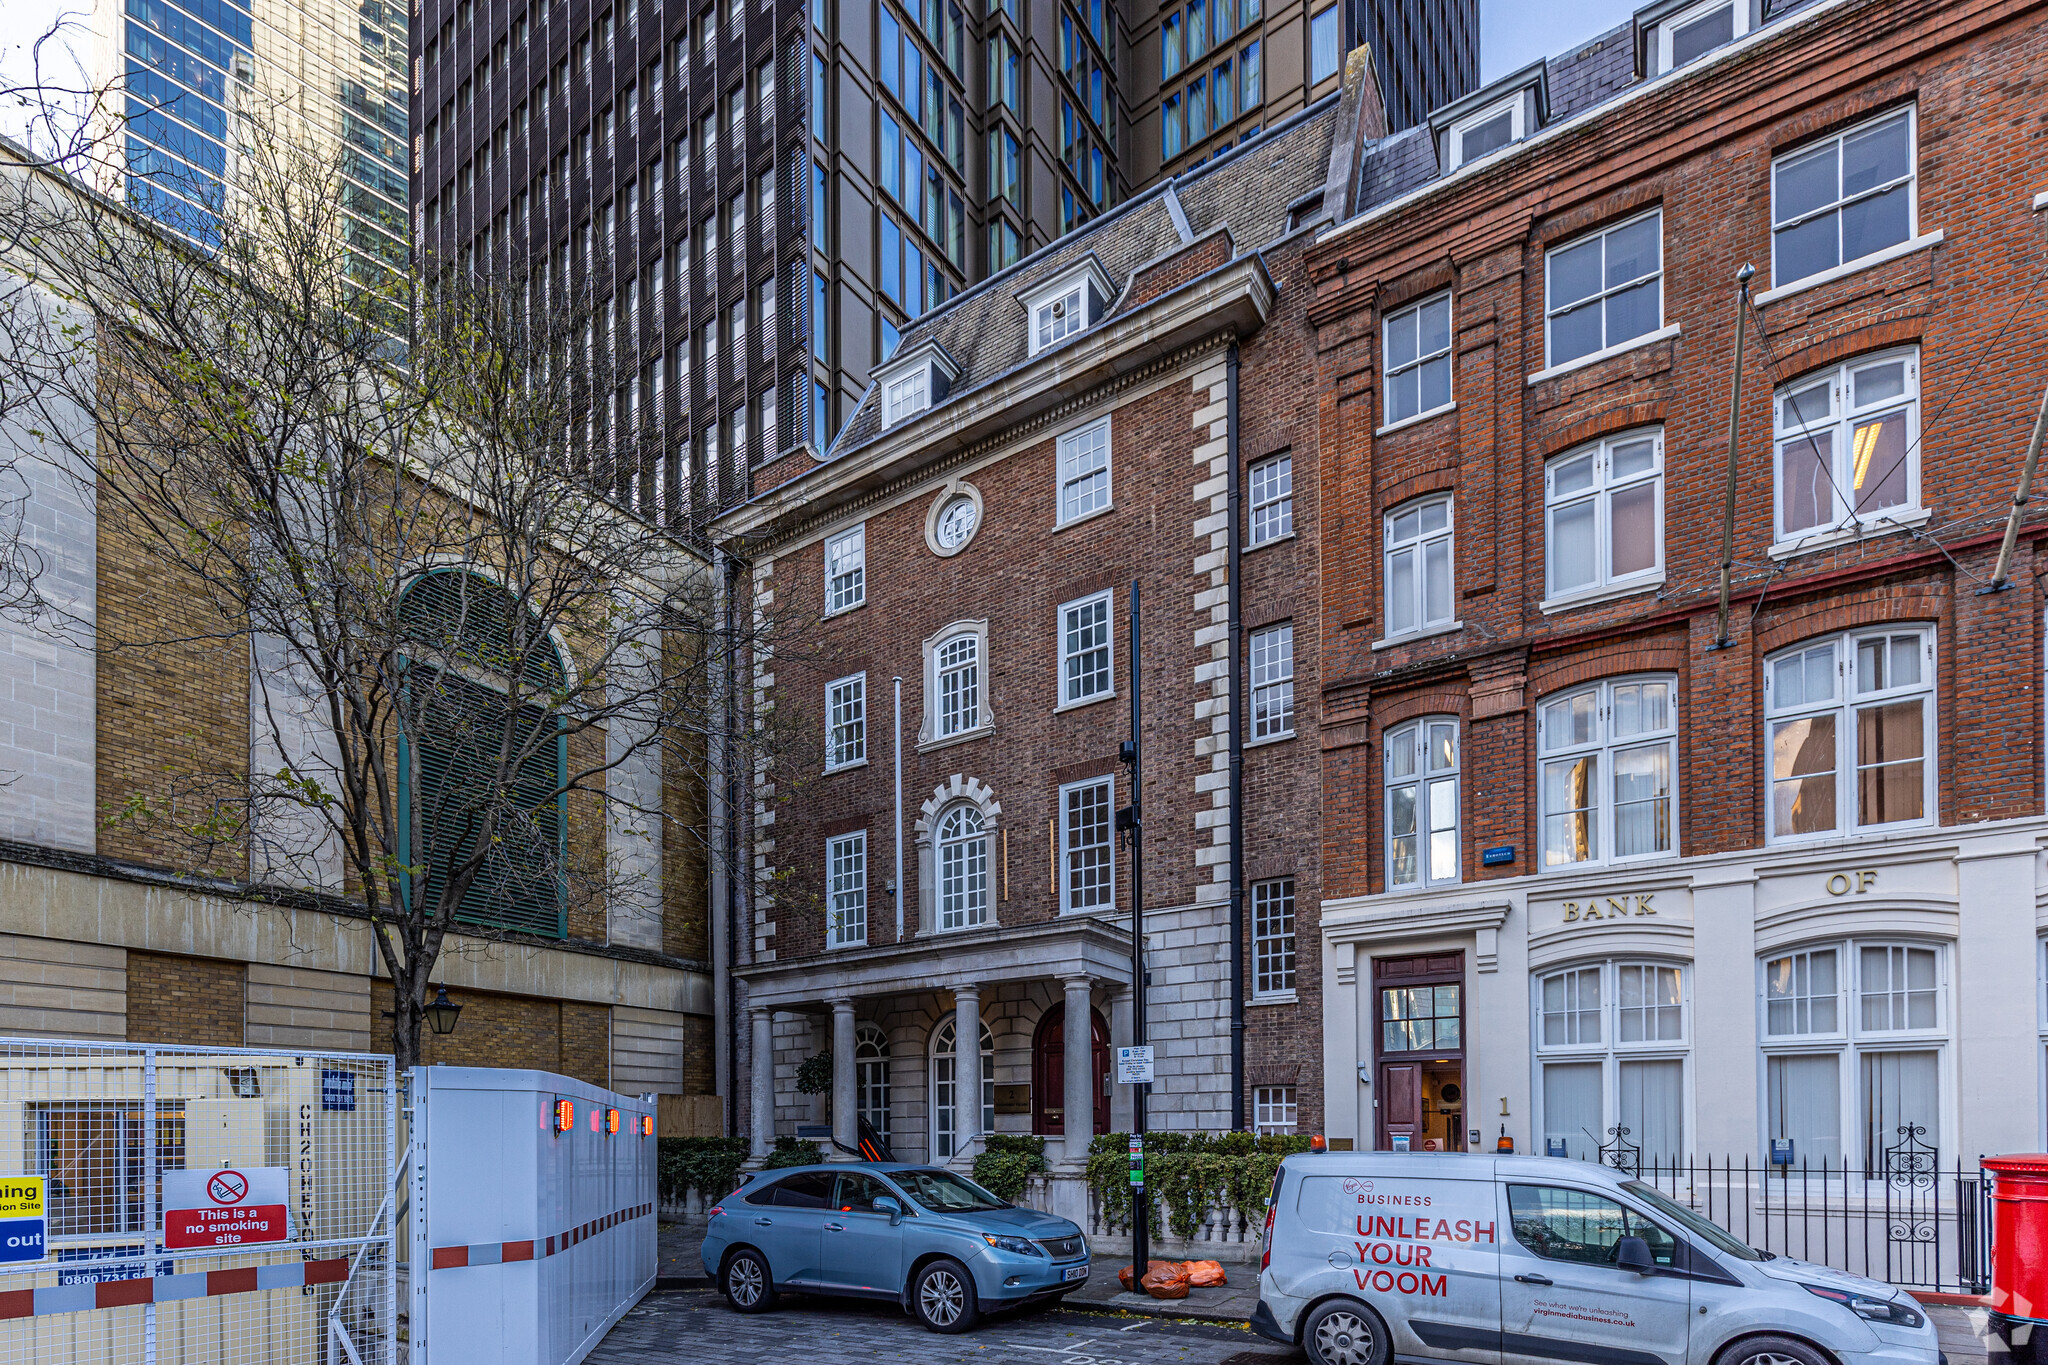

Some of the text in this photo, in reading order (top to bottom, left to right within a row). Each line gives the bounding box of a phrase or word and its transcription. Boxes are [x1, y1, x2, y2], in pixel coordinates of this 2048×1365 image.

[1563, 870, 1878, 922] BANK OF
[1500, 1097, 1510, 1116] 1
[20, 1202, 41, 1210] Site
[1358, 1195, 1432, 1206] BUSINESS
[198, 1209, 257, 1220] This is a
[186, 1220, 268, 1234] no smoking
[1357, 1215, 1495, 1244] UNLEASH
[7, 1233, 42, 1247] out
[215, 1233, 241, 1244] site
[1354, 1241, 1432, 1267] YOUR
[65, 1275, 99, 1285] 0800
[1353, 1269, 1447, 1297] VOOM
[1533, 1299, 1629, 1319] See what we're unleashing
[1533, 1308, 1635, 1327] virginmediabusiness.co.uk
